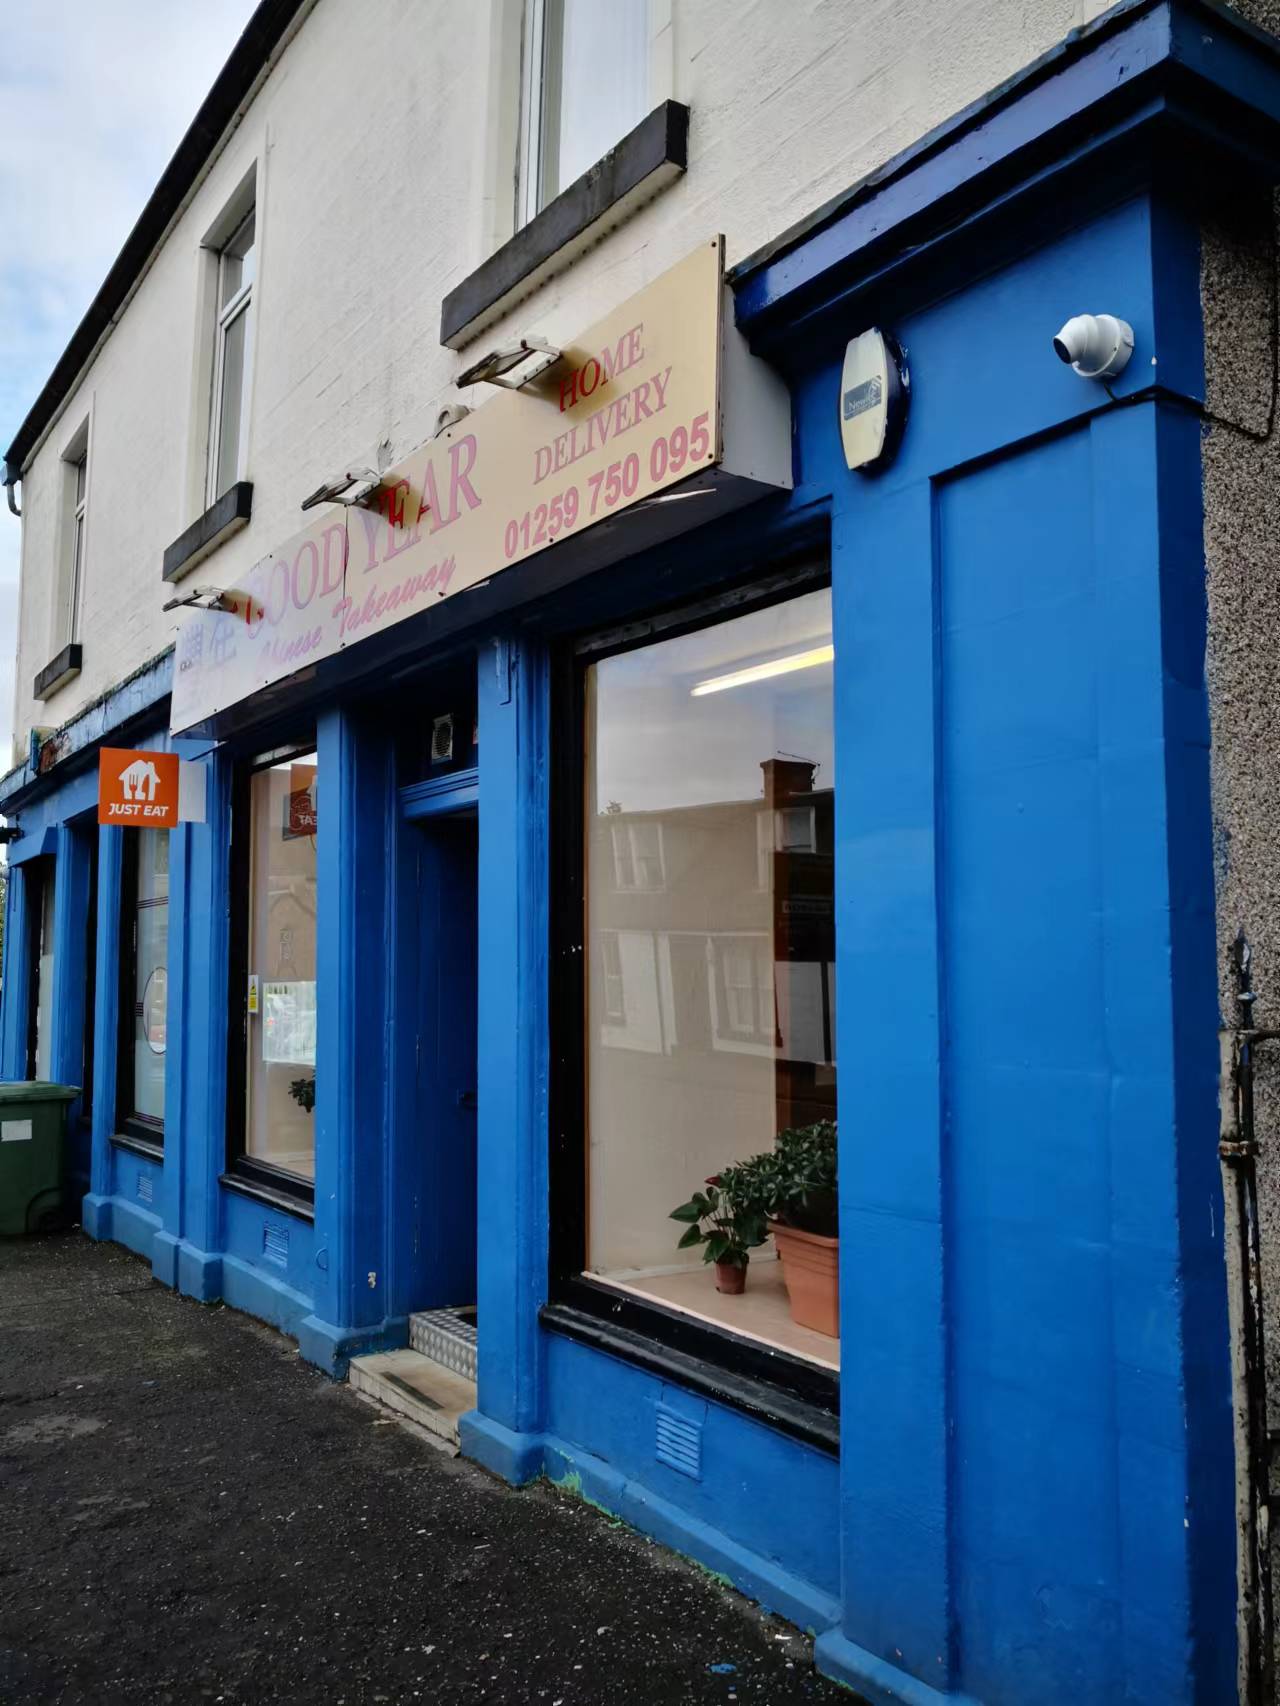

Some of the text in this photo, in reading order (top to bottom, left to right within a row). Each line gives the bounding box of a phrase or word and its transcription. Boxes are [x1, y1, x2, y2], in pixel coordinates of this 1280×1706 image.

[559, 323, 645, 413] HOME
[533, 366, 673, 485] DELIVERY
[504, 411, 710, 559] 01259 750 095
[331, 554, 457, 638] Takeaway
[108, 803, 169, 817] JUST EAT
